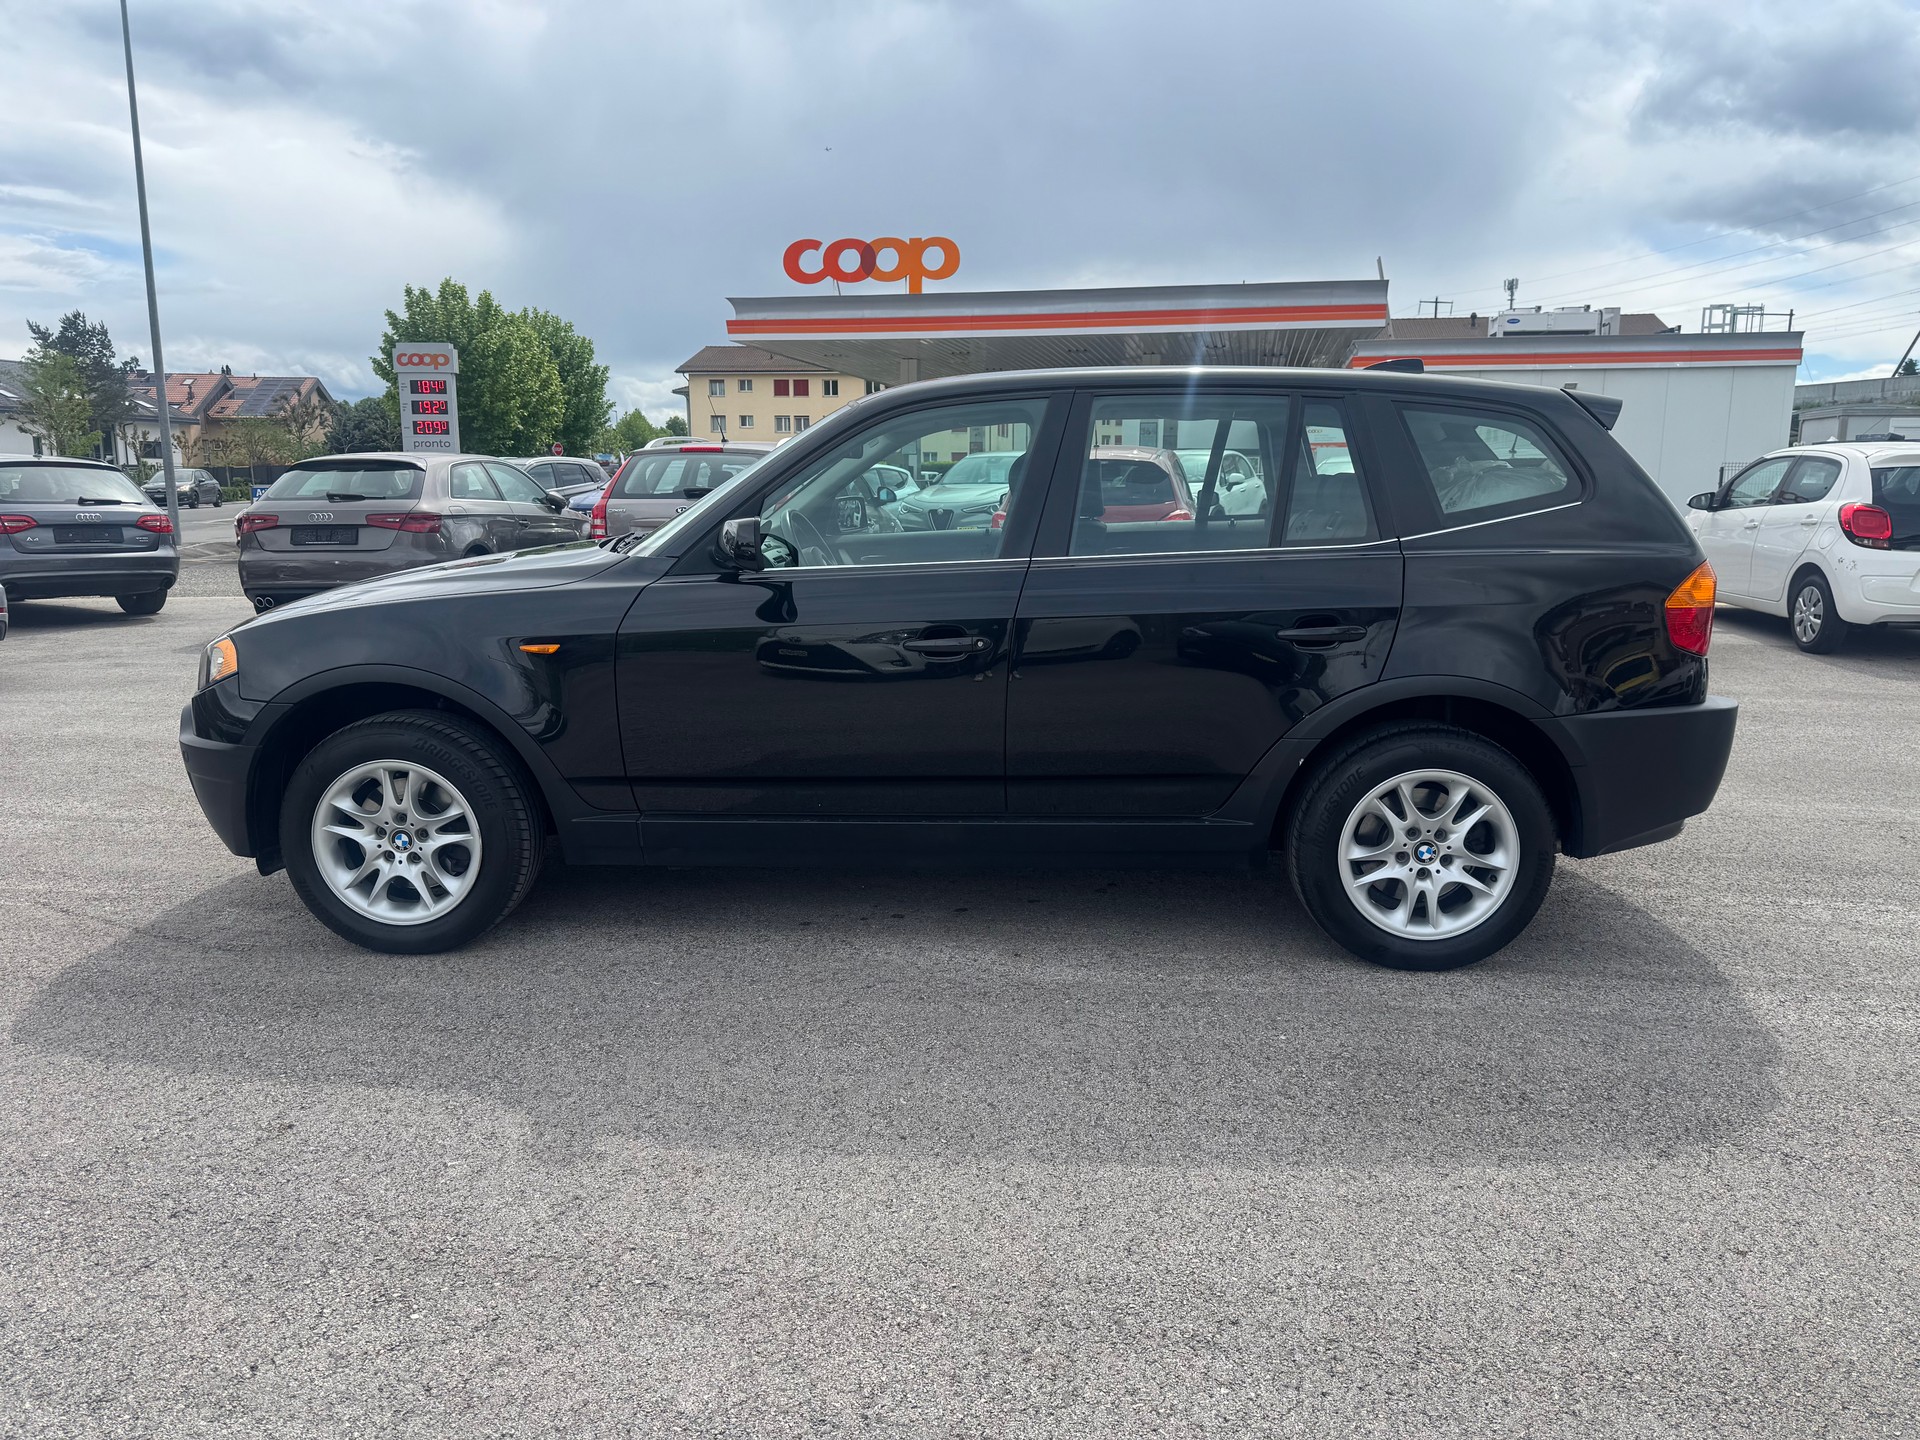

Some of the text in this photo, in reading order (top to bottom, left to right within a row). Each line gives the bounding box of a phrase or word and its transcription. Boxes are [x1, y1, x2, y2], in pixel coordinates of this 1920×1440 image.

[783, 236, 961, 295] coop
[396, 352, 450, 370] coop
[413, 439, 451, 449] pronto
[411, 738, 498, 810] BRIDGESTONE
